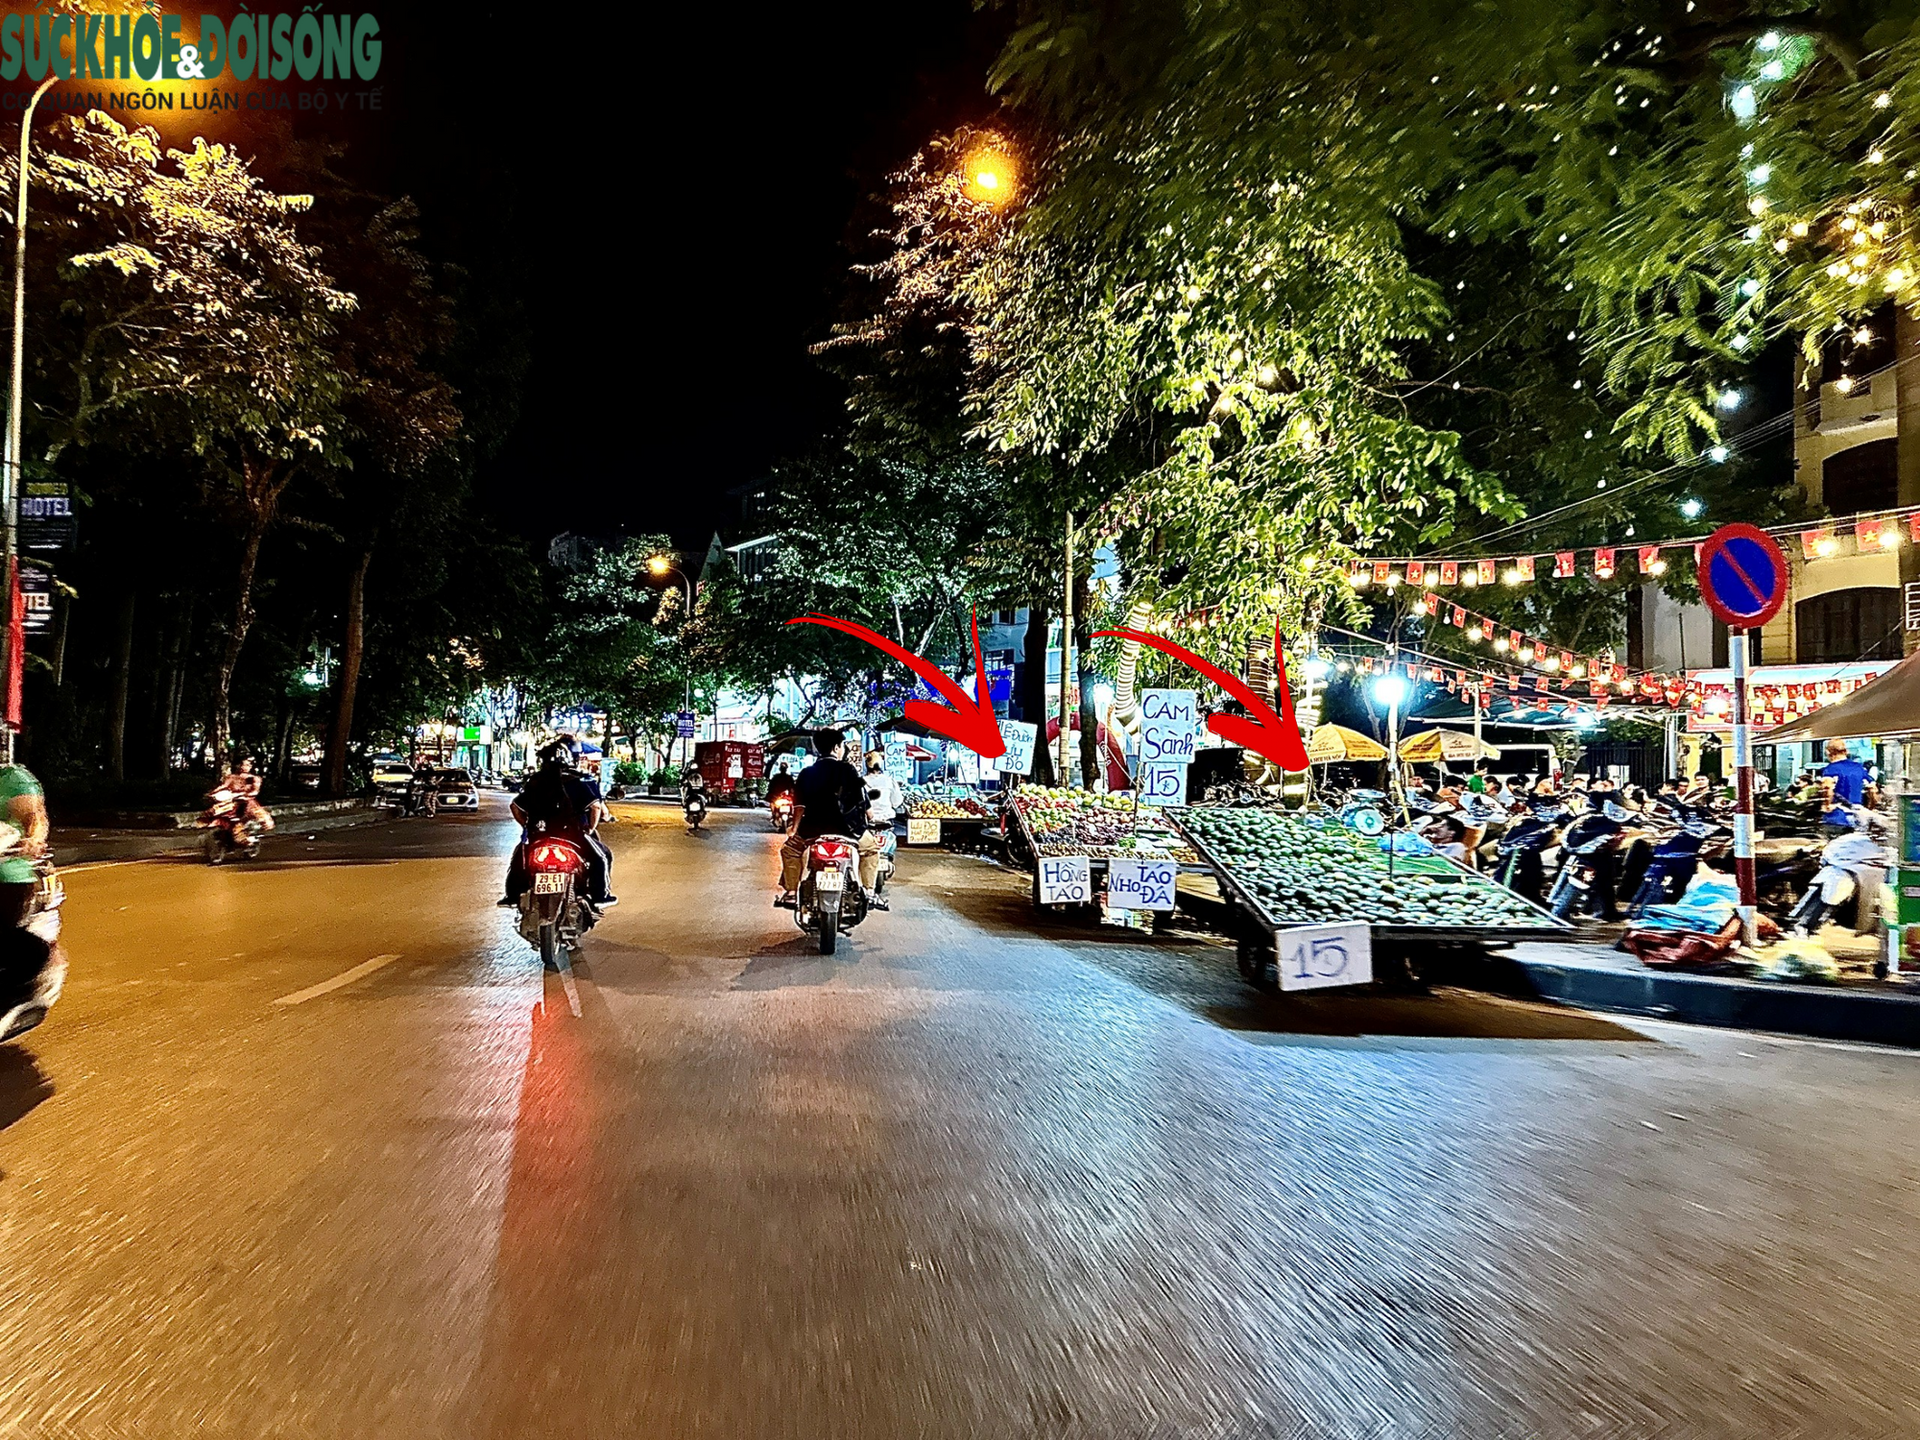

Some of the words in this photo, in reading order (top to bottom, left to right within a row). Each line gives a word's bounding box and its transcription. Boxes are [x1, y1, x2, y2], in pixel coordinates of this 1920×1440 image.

[21, 497, 73, 516] HOTEL
[1144, 727, 1194, 760] Sành
[1044, 861, 1088, 883] HỒNG
[1137, 862, 1172, 885] TÁO
[536, 883, 564, 893] 696.11
[1046, 883, 1084, 901] TÁO
[1108, 872, 1140, 893] NHO
[1139, 885, 1172, 905] ĐÁ
